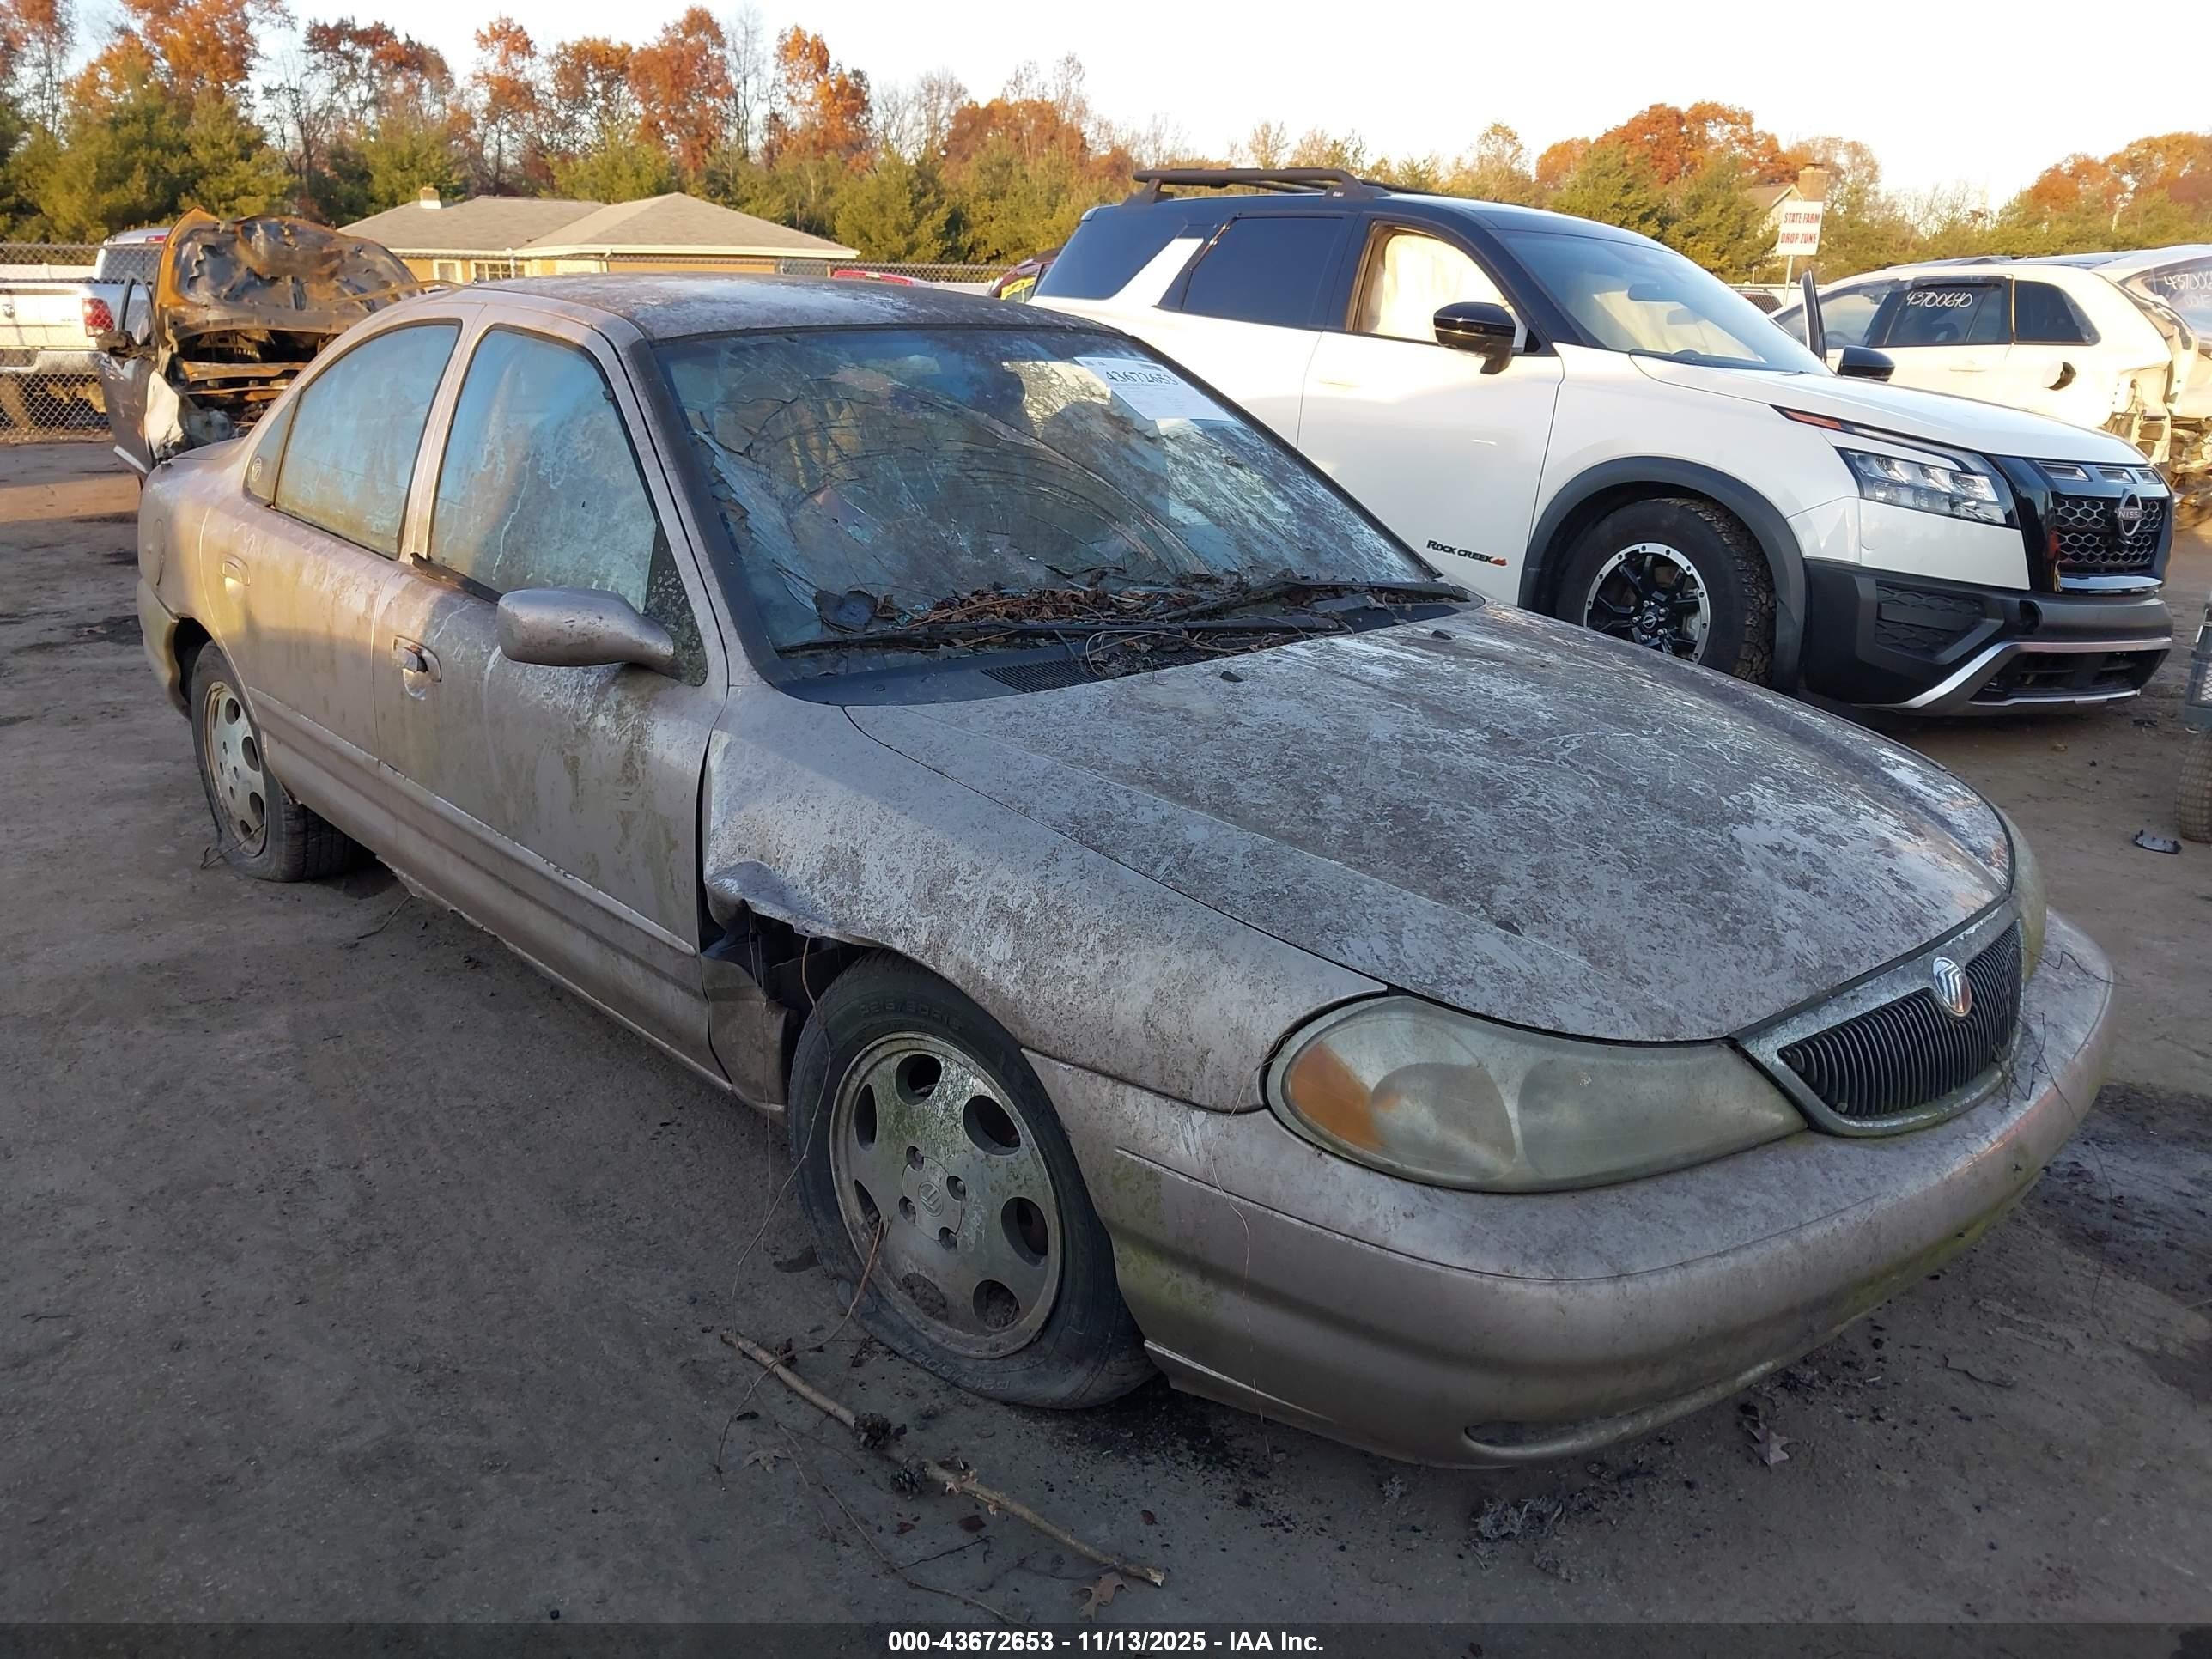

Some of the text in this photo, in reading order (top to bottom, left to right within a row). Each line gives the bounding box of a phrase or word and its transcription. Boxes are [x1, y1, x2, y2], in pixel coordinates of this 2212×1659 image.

[1784, 212, 1820, 224] STATE FARM
[1780, 233, 1817, 244] DROP ZONE
[1906, 290, 1973, 307] 43700640
[1105, 370, 1179, 386] 43672653
[1457, 549, 1494, 564] CREEK
